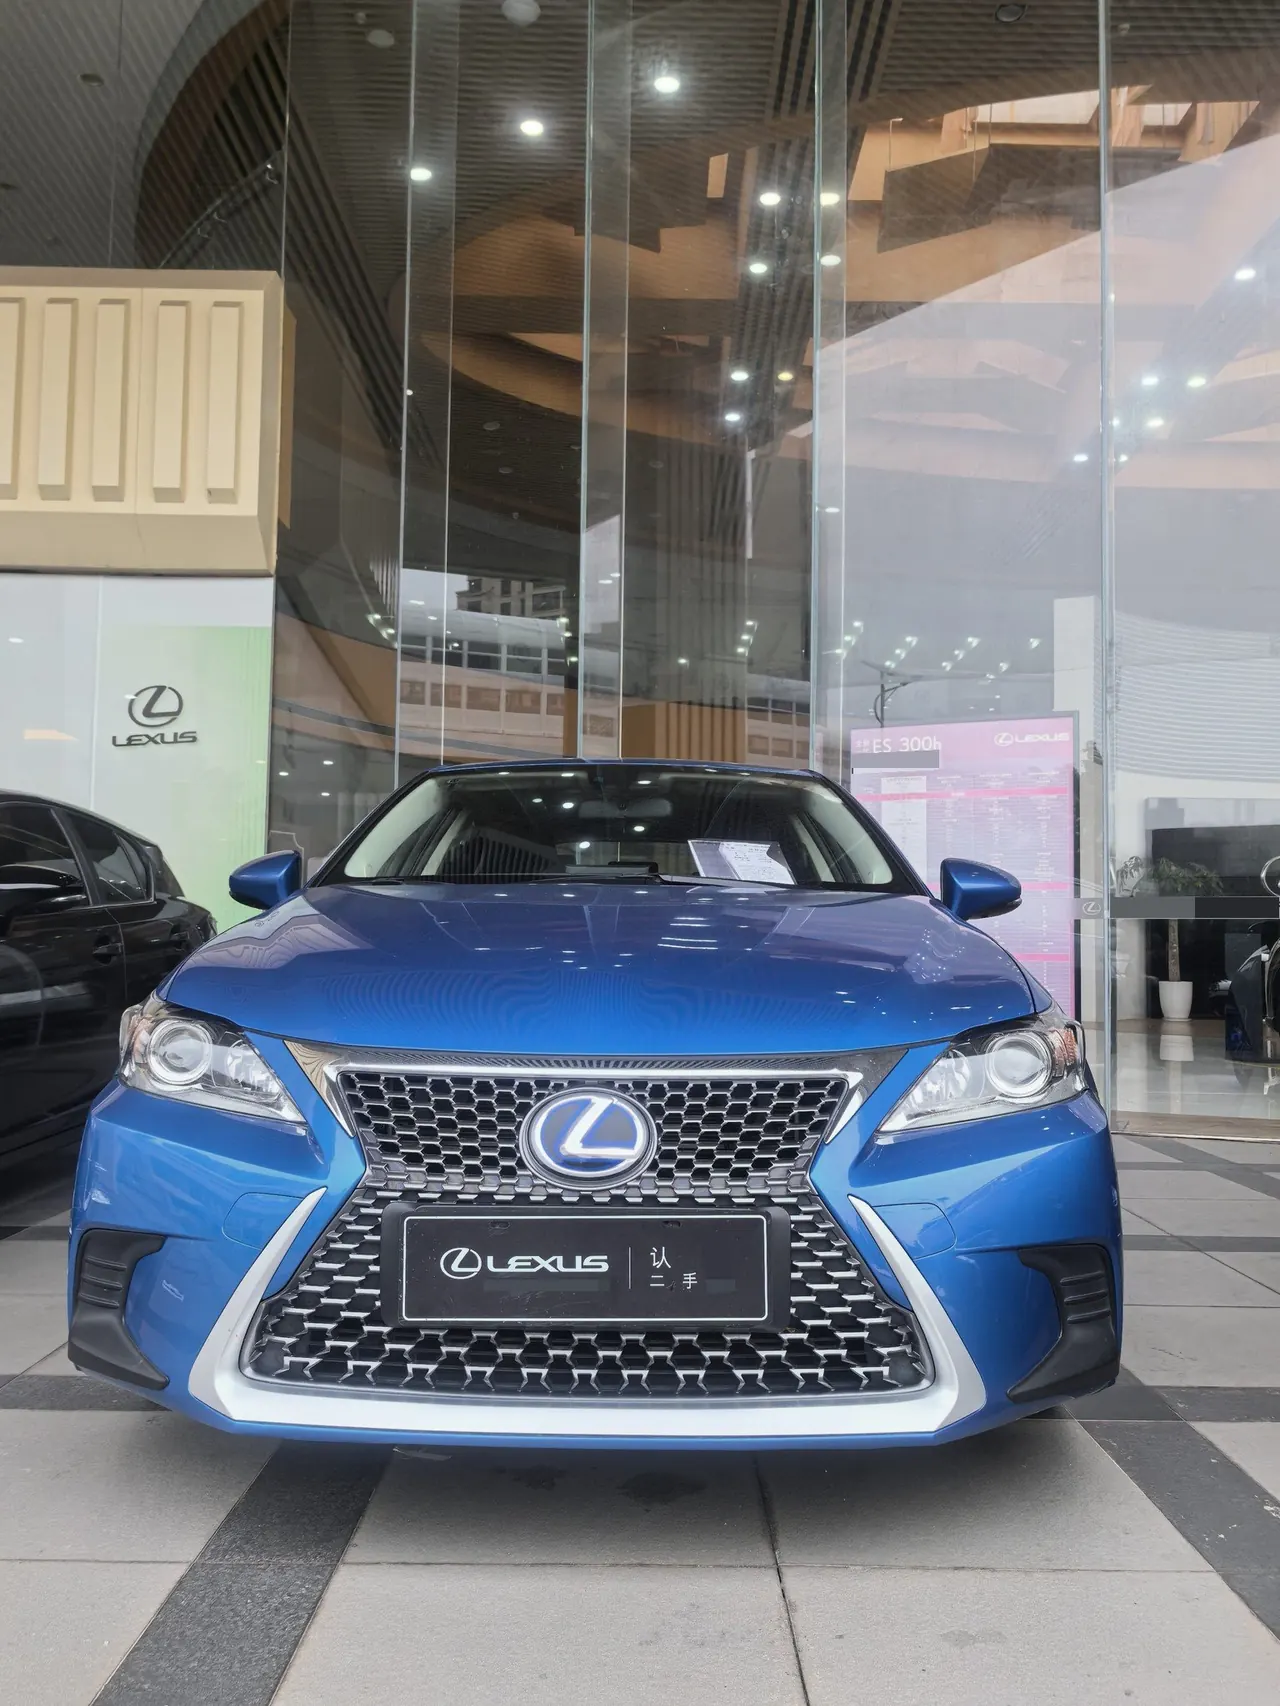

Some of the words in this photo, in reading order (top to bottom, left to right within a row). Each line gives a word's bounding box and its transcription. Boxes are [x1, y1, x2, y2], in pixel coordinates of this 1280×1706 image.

[112, 731, 197, 747] LEXUS
[873, 738, 892, 753] ES
[899, 736, 942, 751] 300h
[1015, 732, 1069, 742] LEXUS
[487, 1256, 609, 1272] LEXUS
[650, 1246, 671, 1269] 认
